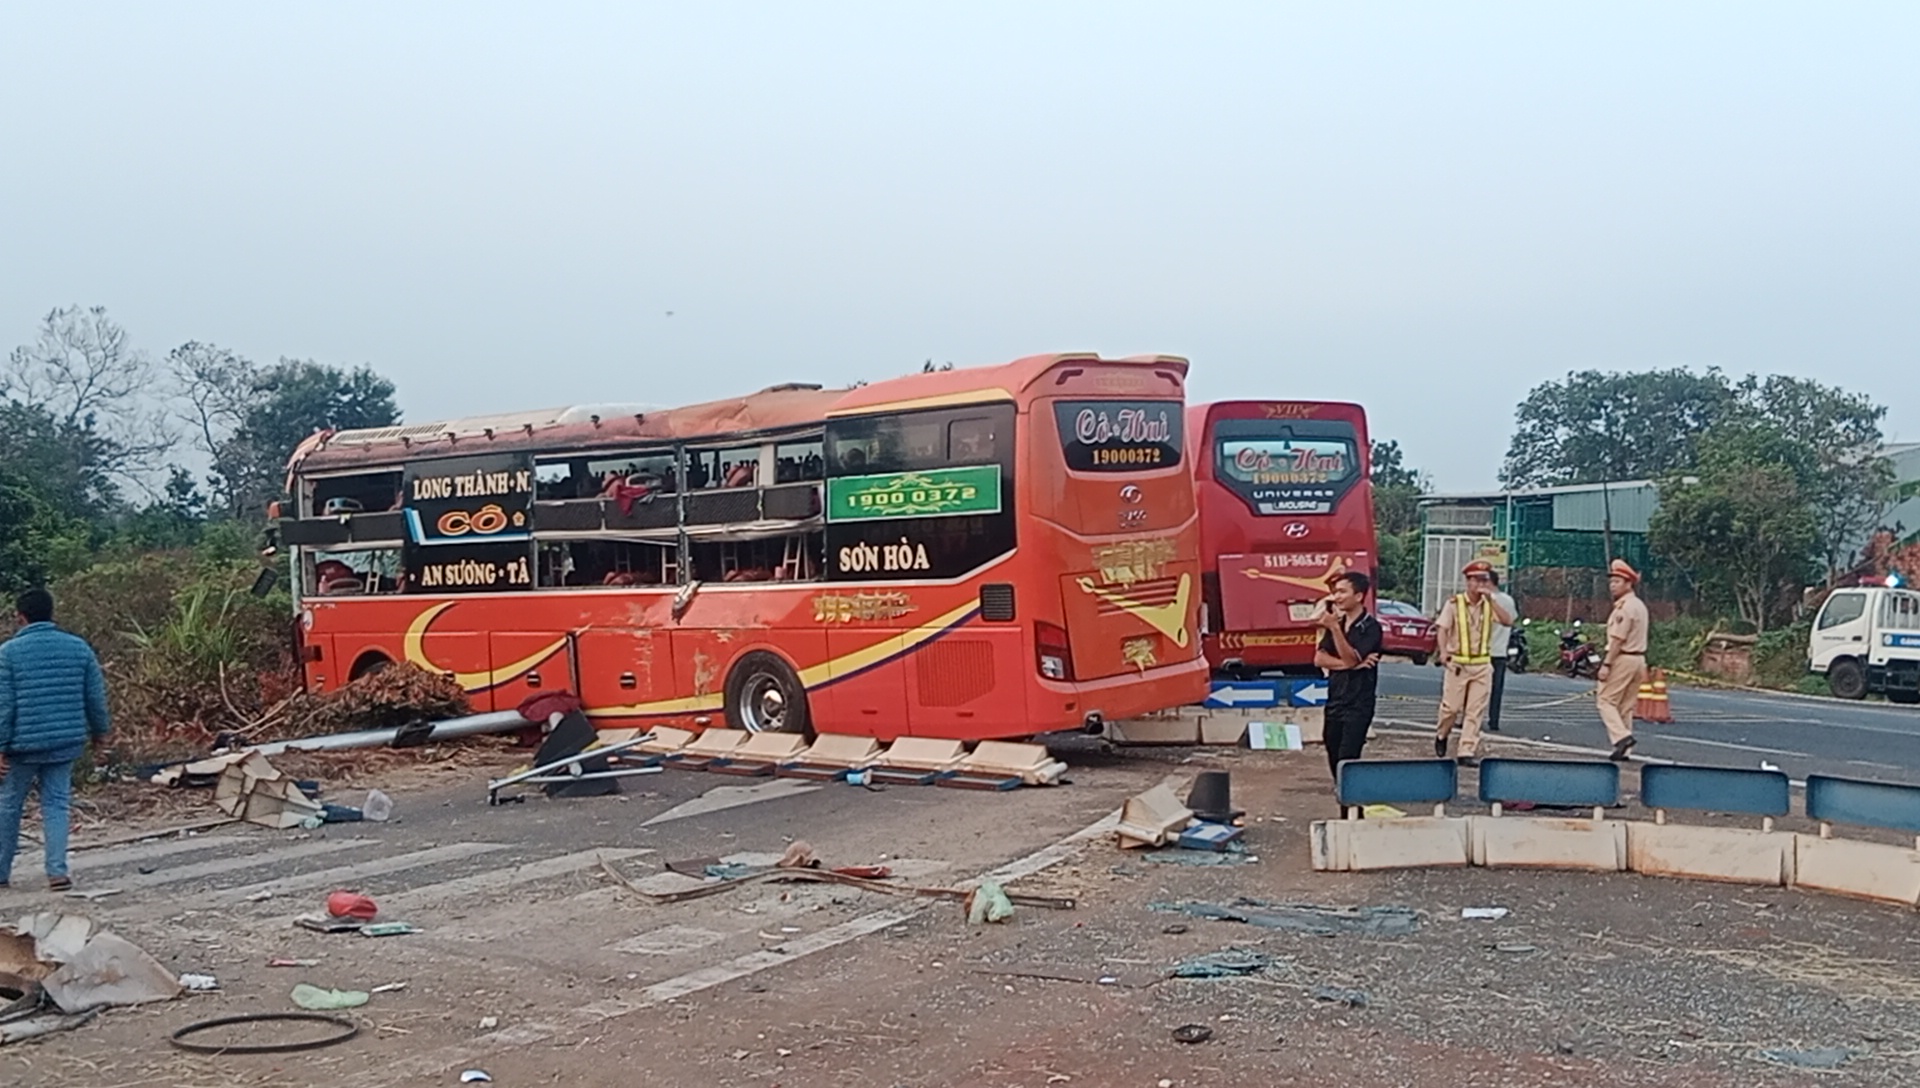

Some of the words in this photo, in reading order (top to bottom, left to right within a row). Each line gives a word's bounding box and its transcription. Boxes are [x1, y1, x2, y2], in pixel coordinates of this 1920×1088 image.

[1092, 448, 1161, 465] 19000372
[413, 477, 452, 500] LONG
[454, 469, 509, 497] THÀNH
[516, 471, 532, 492] N
[1252, 472, 1328, 485] 19000372
[848, 491, 905, 507] 1900
[911, 487, 976, 502] 0372
[1253, 490, 1334, 499] UNIVERSE
[437, 504, 508, 536] CÔ
[839, 541, 879, 572] SƠN
[883, 536, 930, 570] HÒA
[421, 565, 443, 586] AN
[445, 559, 496, 585] SƯƠNG
[507, 556, 530, 584] TÂ
